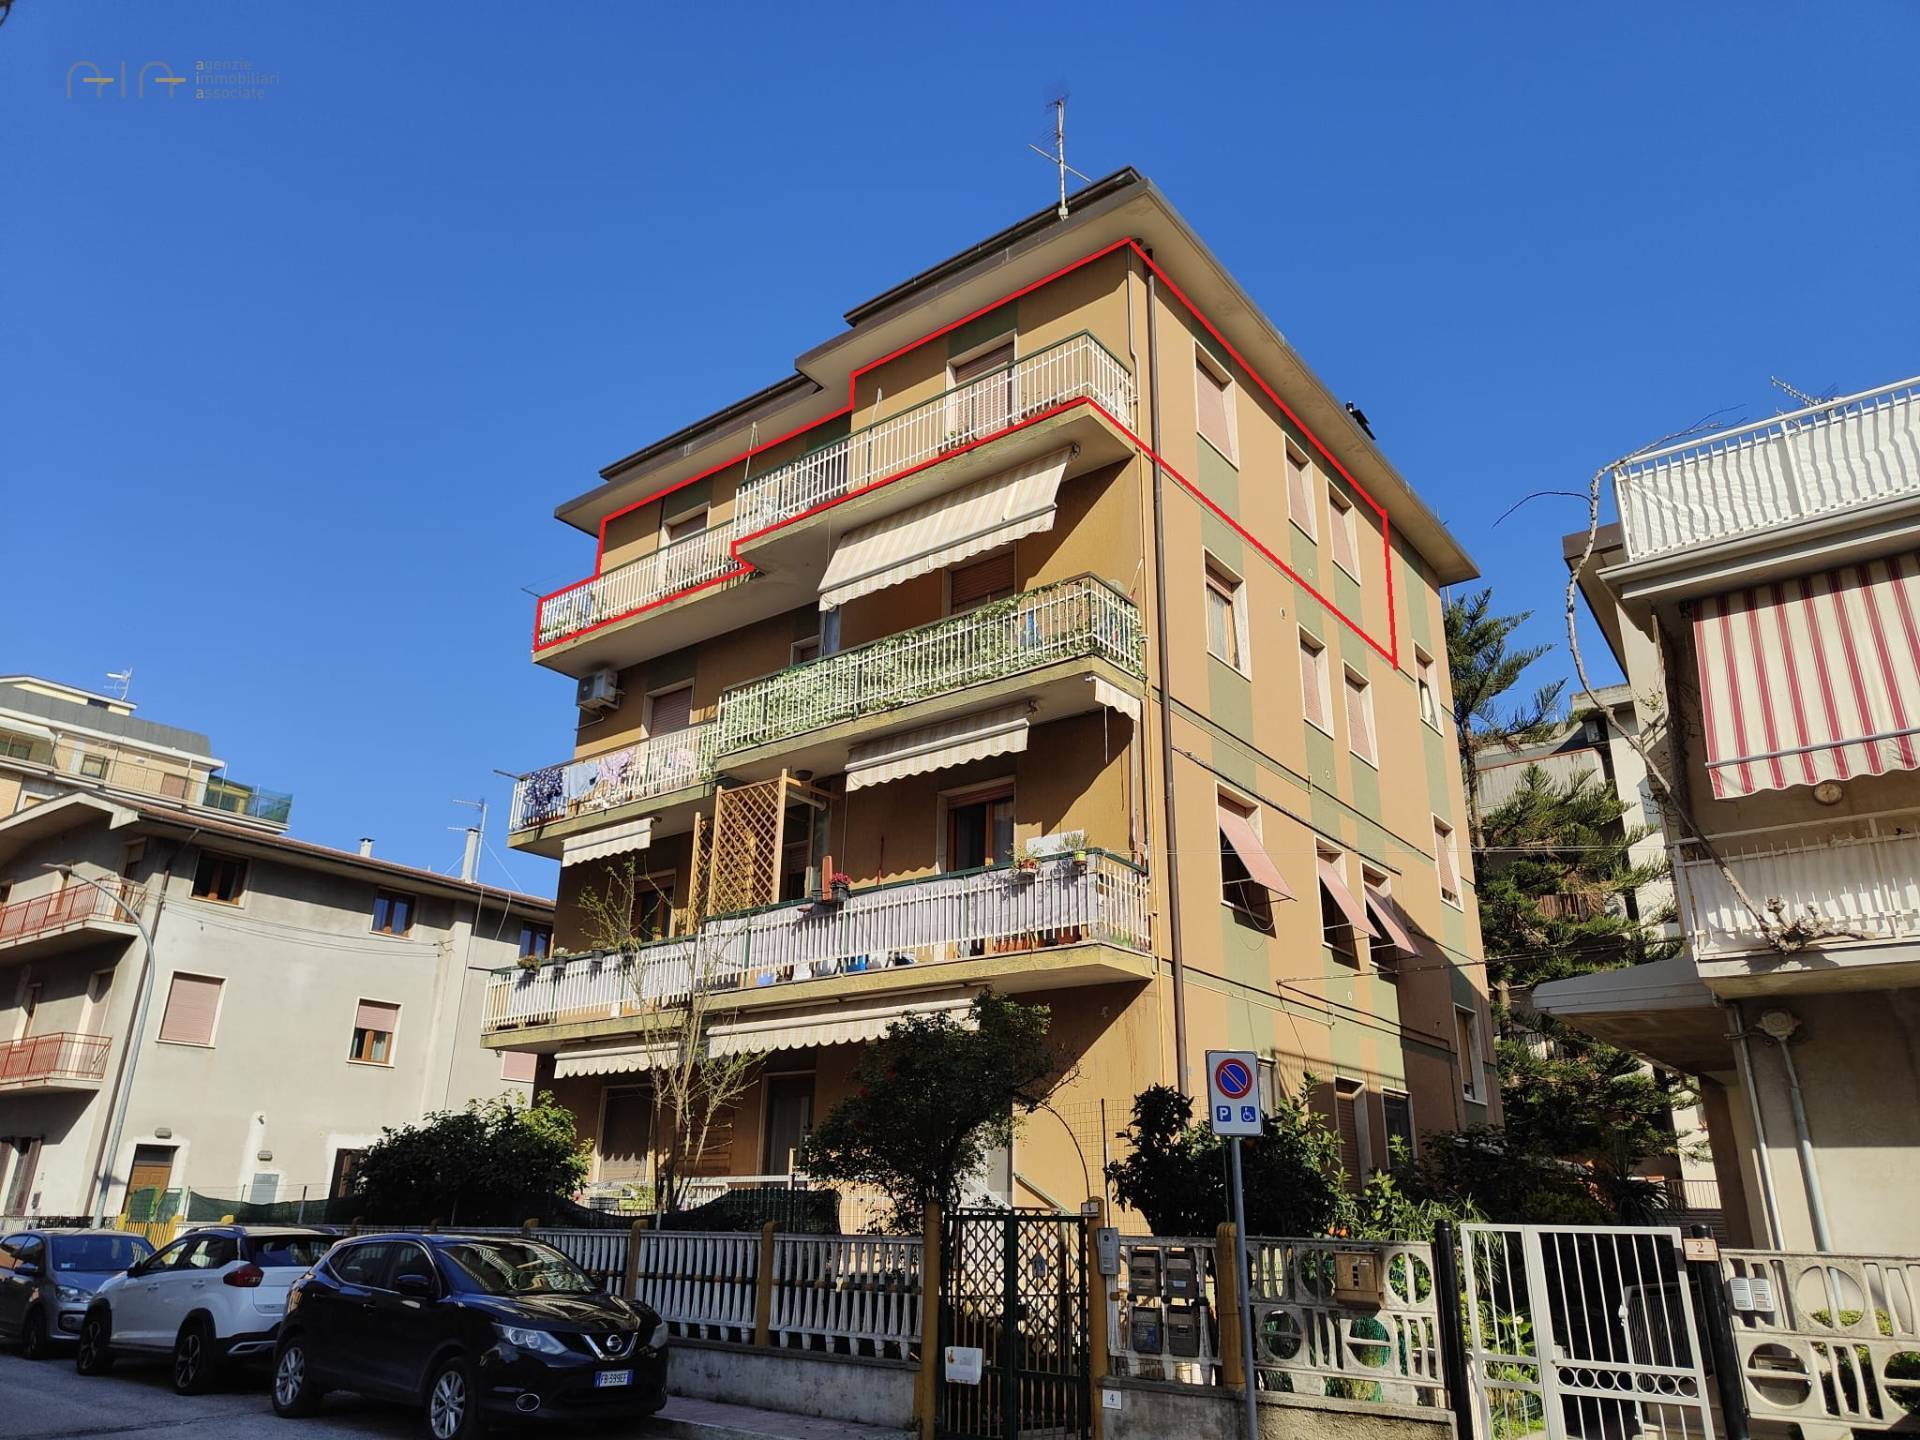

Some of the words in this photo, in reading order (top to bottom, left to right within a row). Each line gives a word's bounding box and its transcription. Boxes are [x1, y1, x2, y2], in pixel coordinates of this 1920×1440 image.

[1219, 1107, 1229, 1120] P
[1696, 1241, 1704, 1253] 2
[1109, 1393, 1115, 1403] 4
